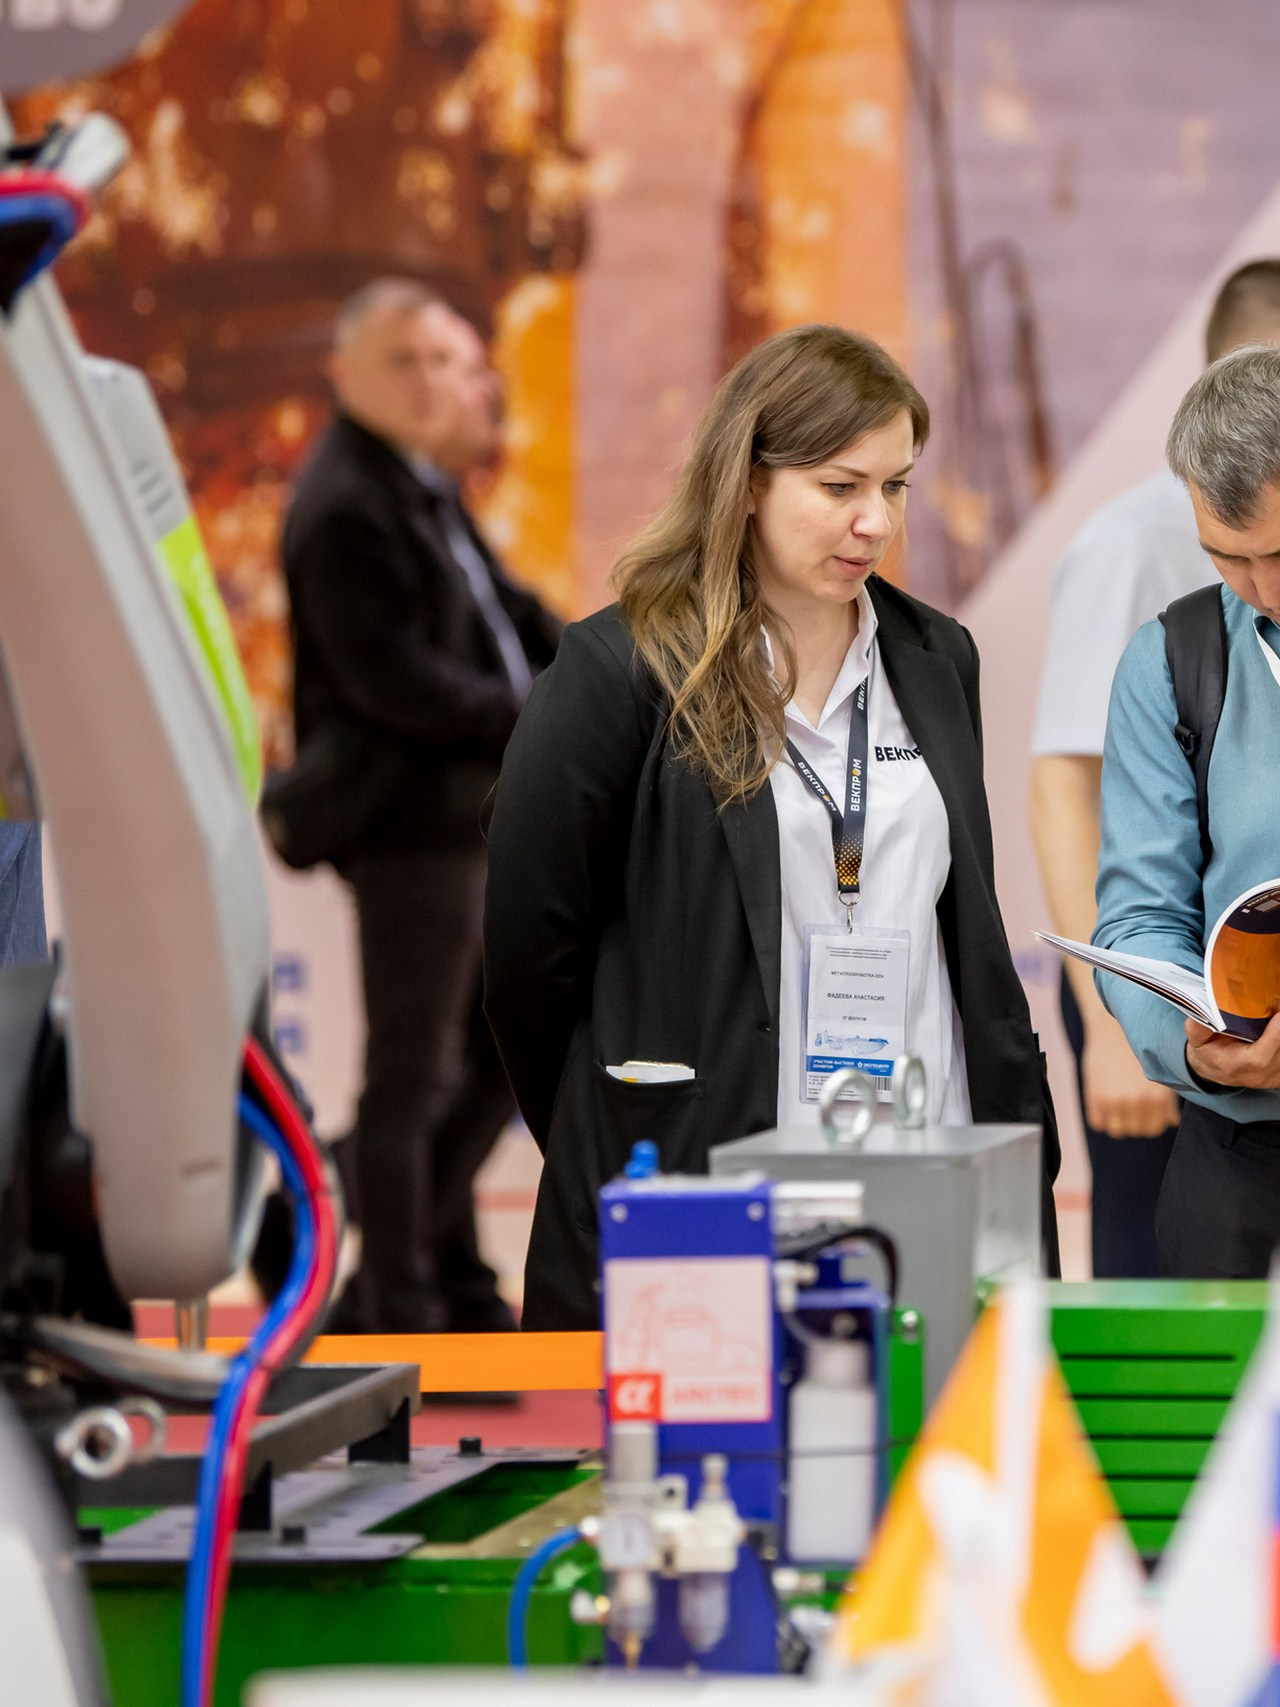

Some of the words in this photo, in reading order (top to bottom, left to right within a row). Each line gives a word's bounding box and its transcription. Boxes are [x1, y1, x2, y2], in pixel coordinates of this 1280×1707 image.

[797, 761, 837, 812] ВЕКПРОМ
[850, 758, 862, 812] ВЕКПРОМ
[827, 992, 852, 1000] ФАДЕЕВА
